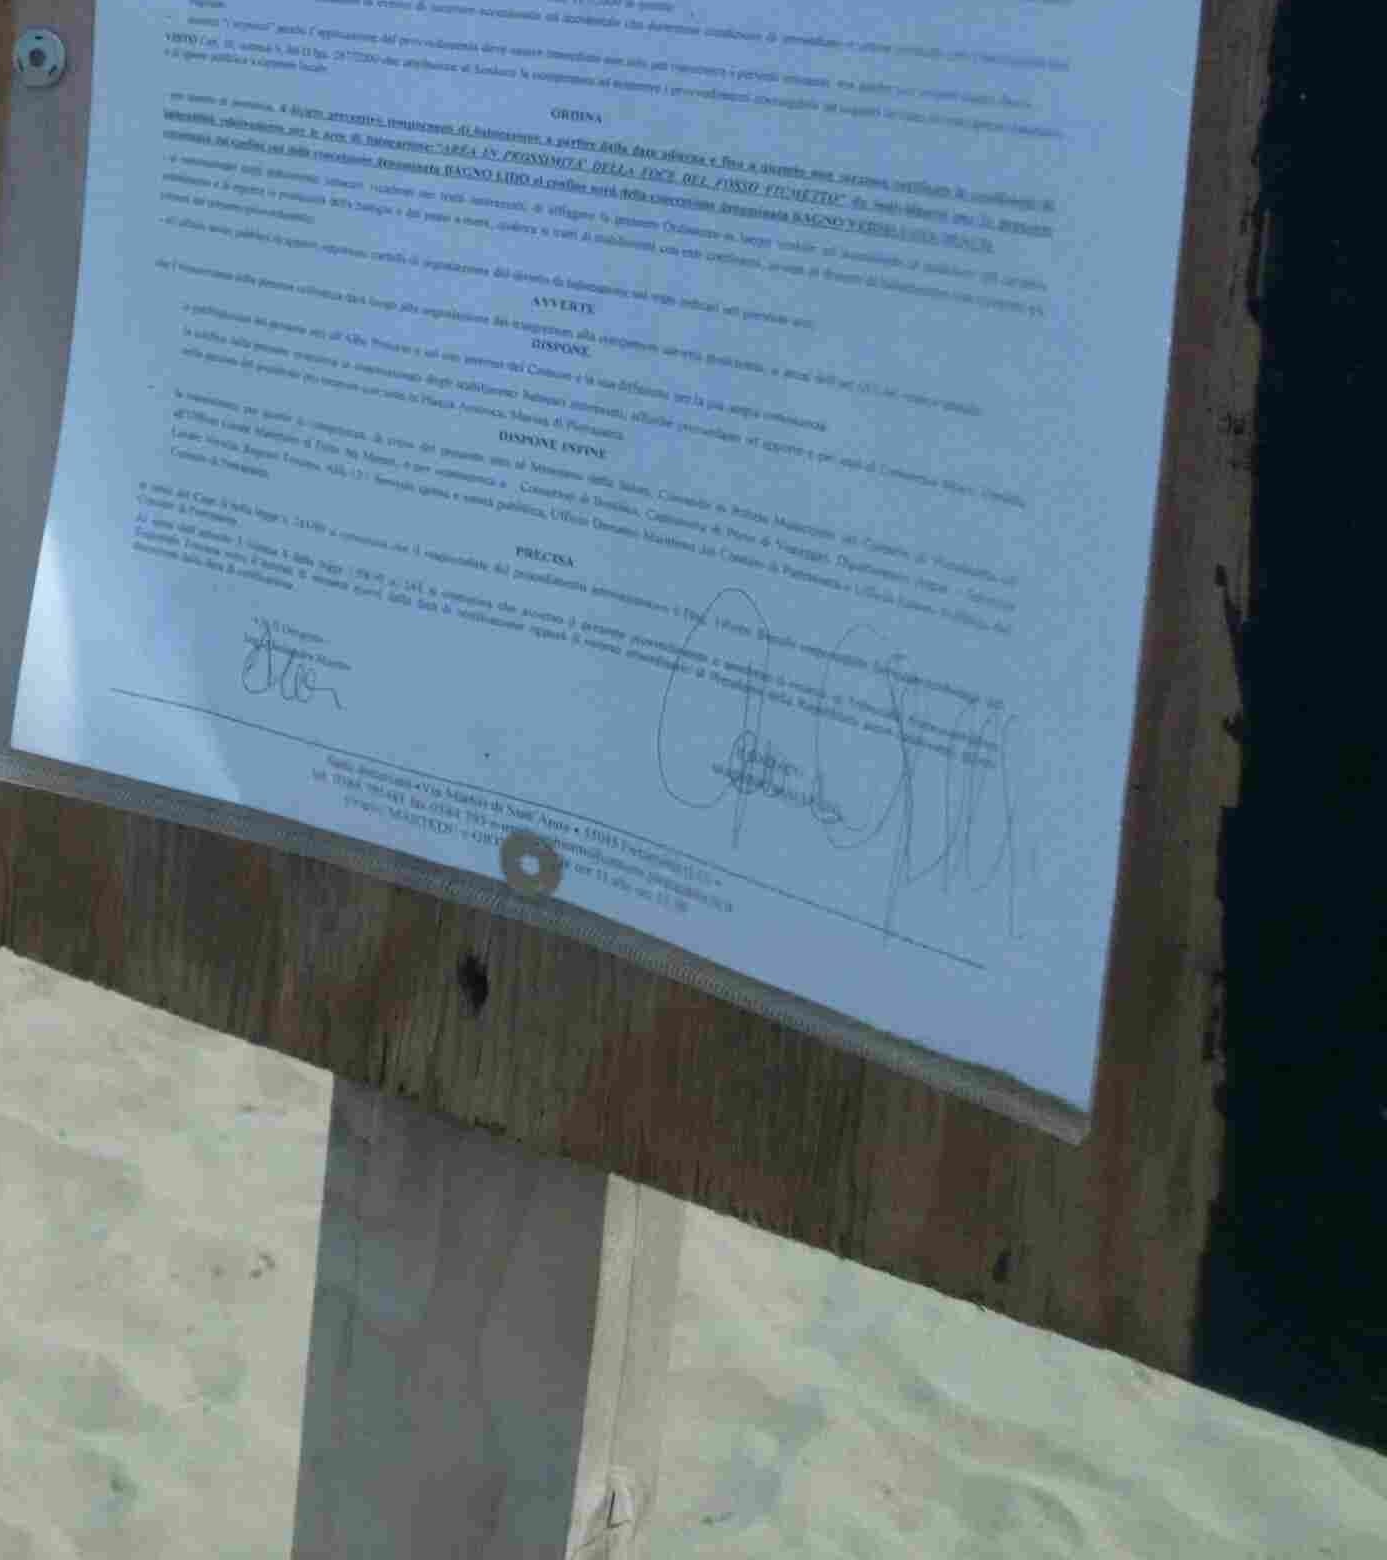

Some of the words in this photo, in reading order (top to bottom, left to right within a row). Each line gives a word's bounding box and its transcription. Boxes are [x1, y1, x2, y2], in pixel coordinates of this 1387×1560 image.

[549, 106, 603, 124] ORDINA
[531, 338, 592, 358] DISPONE
[499, 430, 558, 451] DISPONE
[561, 438, 609, 461] INFINE
[515, 545, 576, 568] PRECISA
